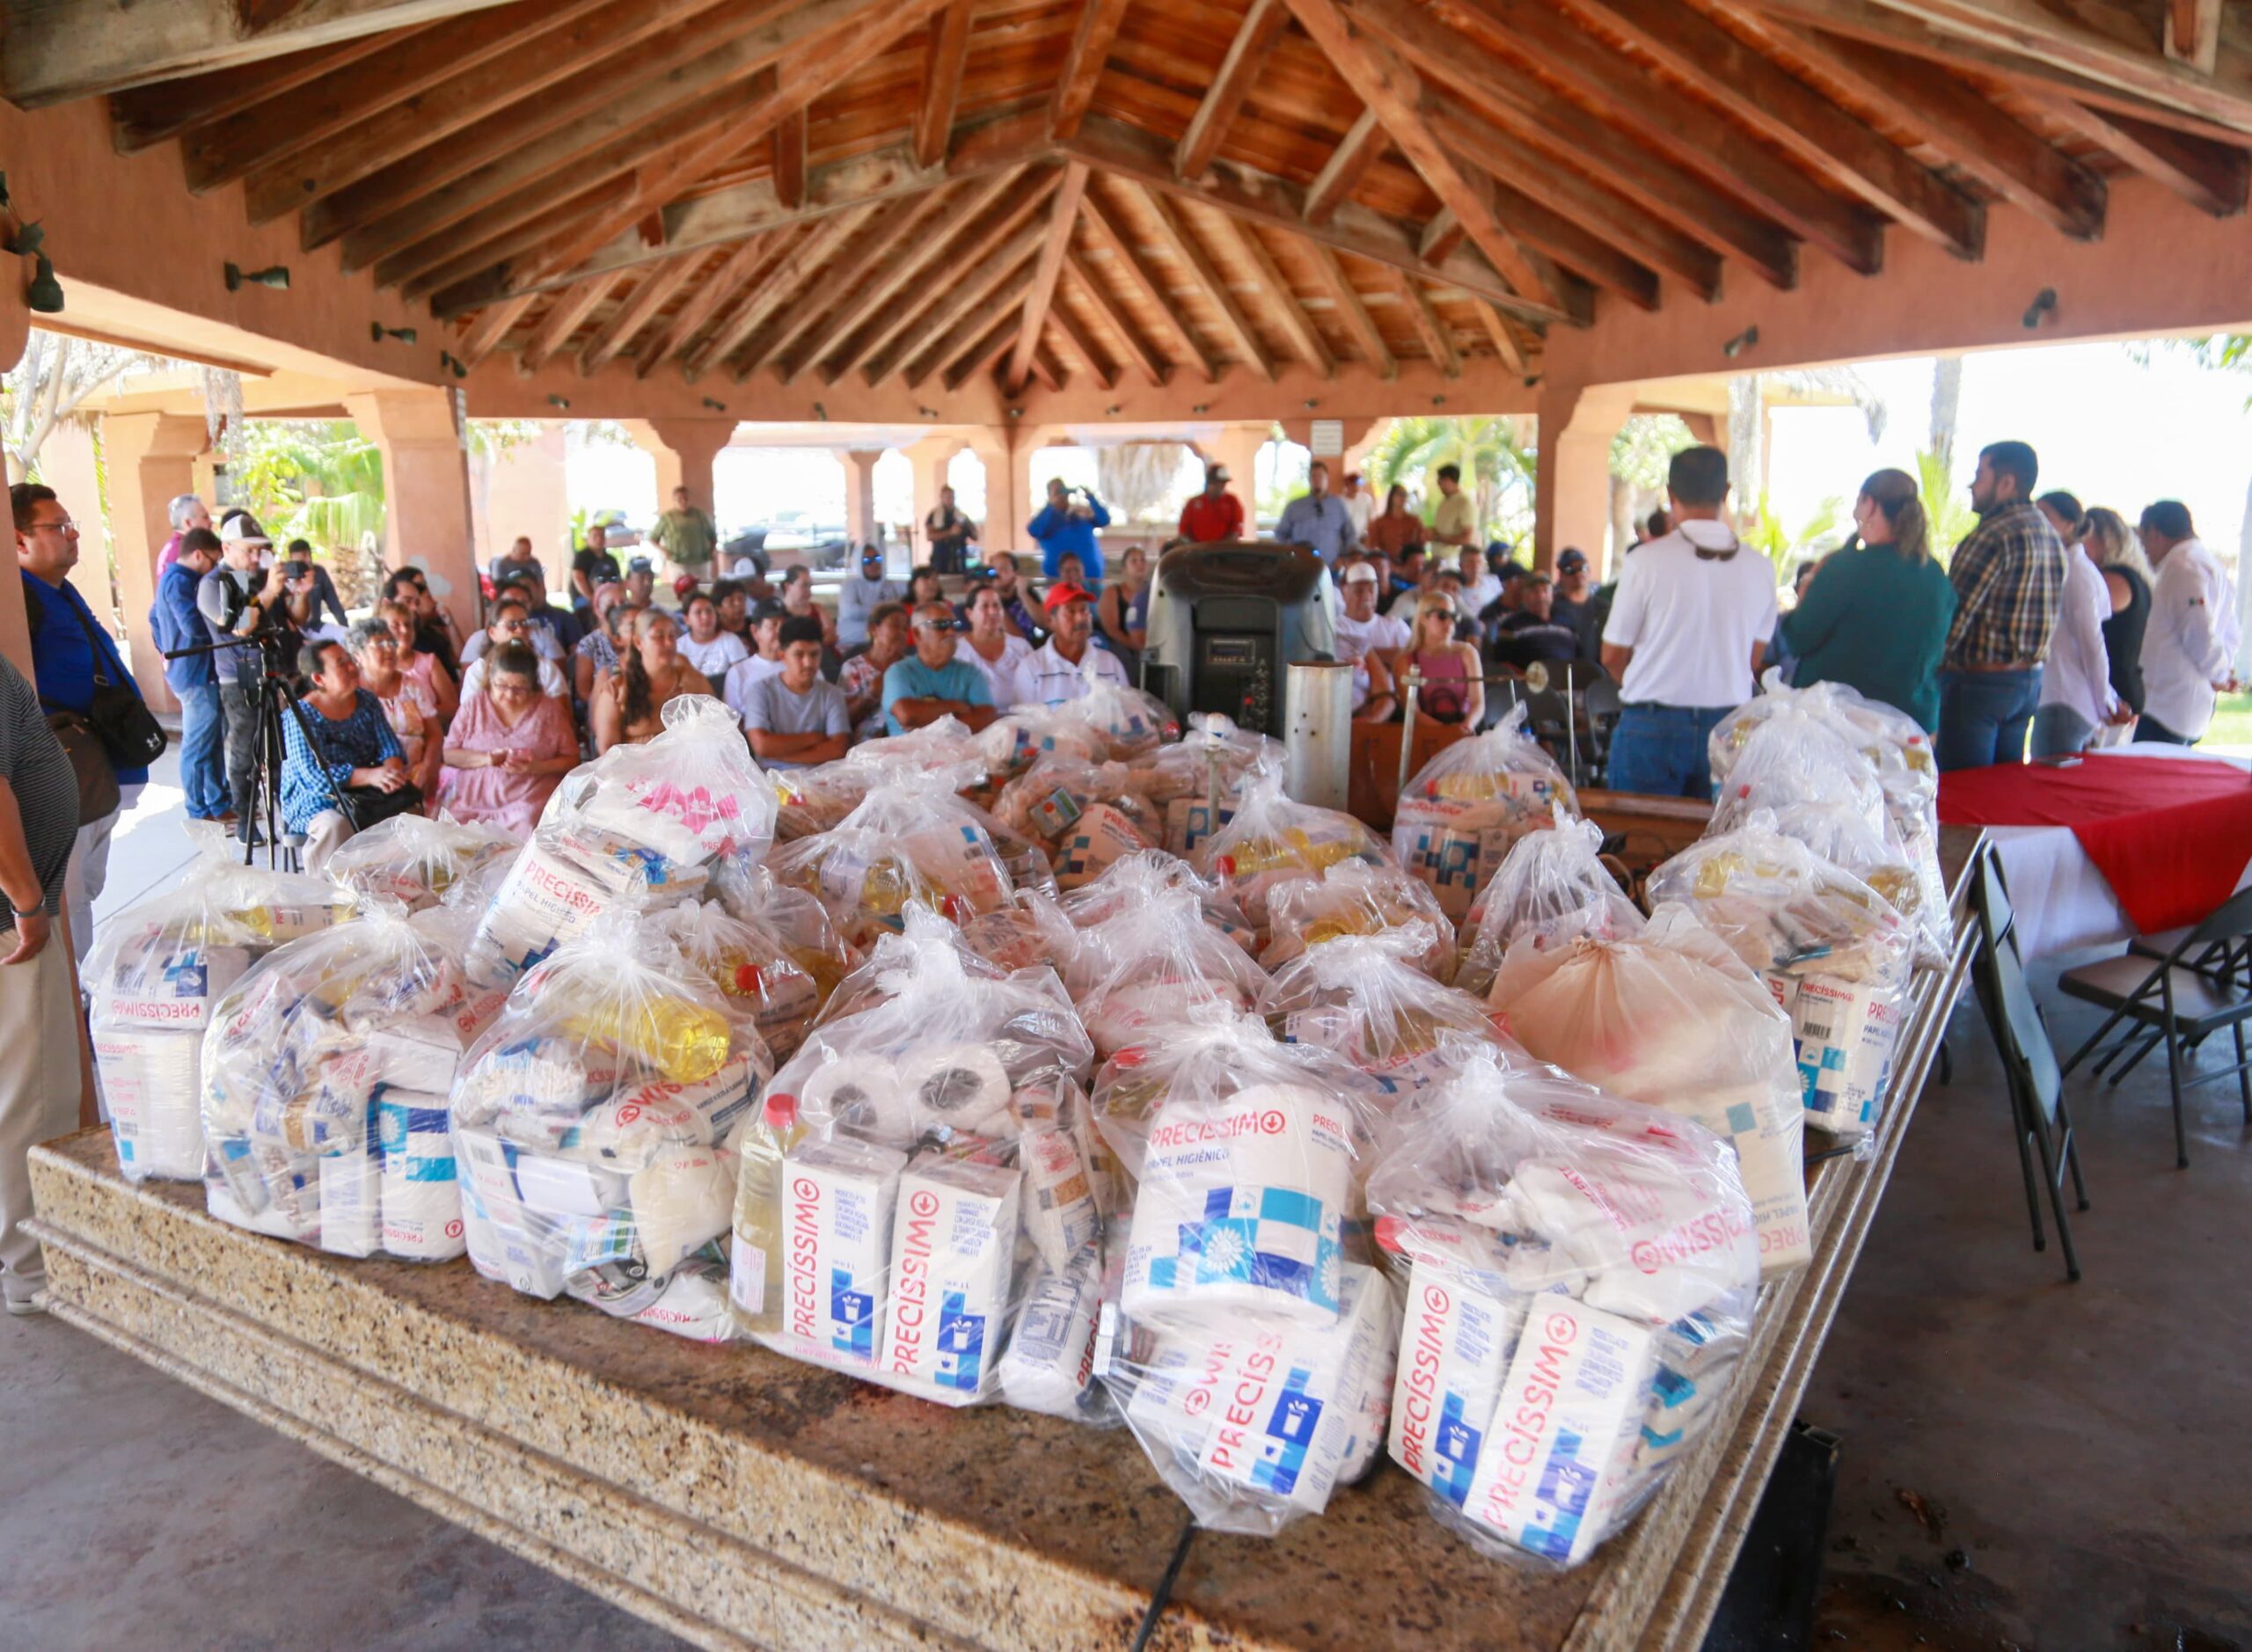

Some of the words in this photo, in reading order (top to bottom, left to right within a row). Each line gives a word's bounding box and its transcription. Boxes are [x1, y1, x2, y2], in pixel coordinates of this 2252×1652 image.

[787, 1177, 820, 1340] PRECÍSSIMO
[893, 1190, 940, 1378] PRECÍSSIMO
[1401, 1284, 1450, 1476] PRECÍSSIMO
[1484, 1312, 1576, 1531] PRECÍSSIMO
